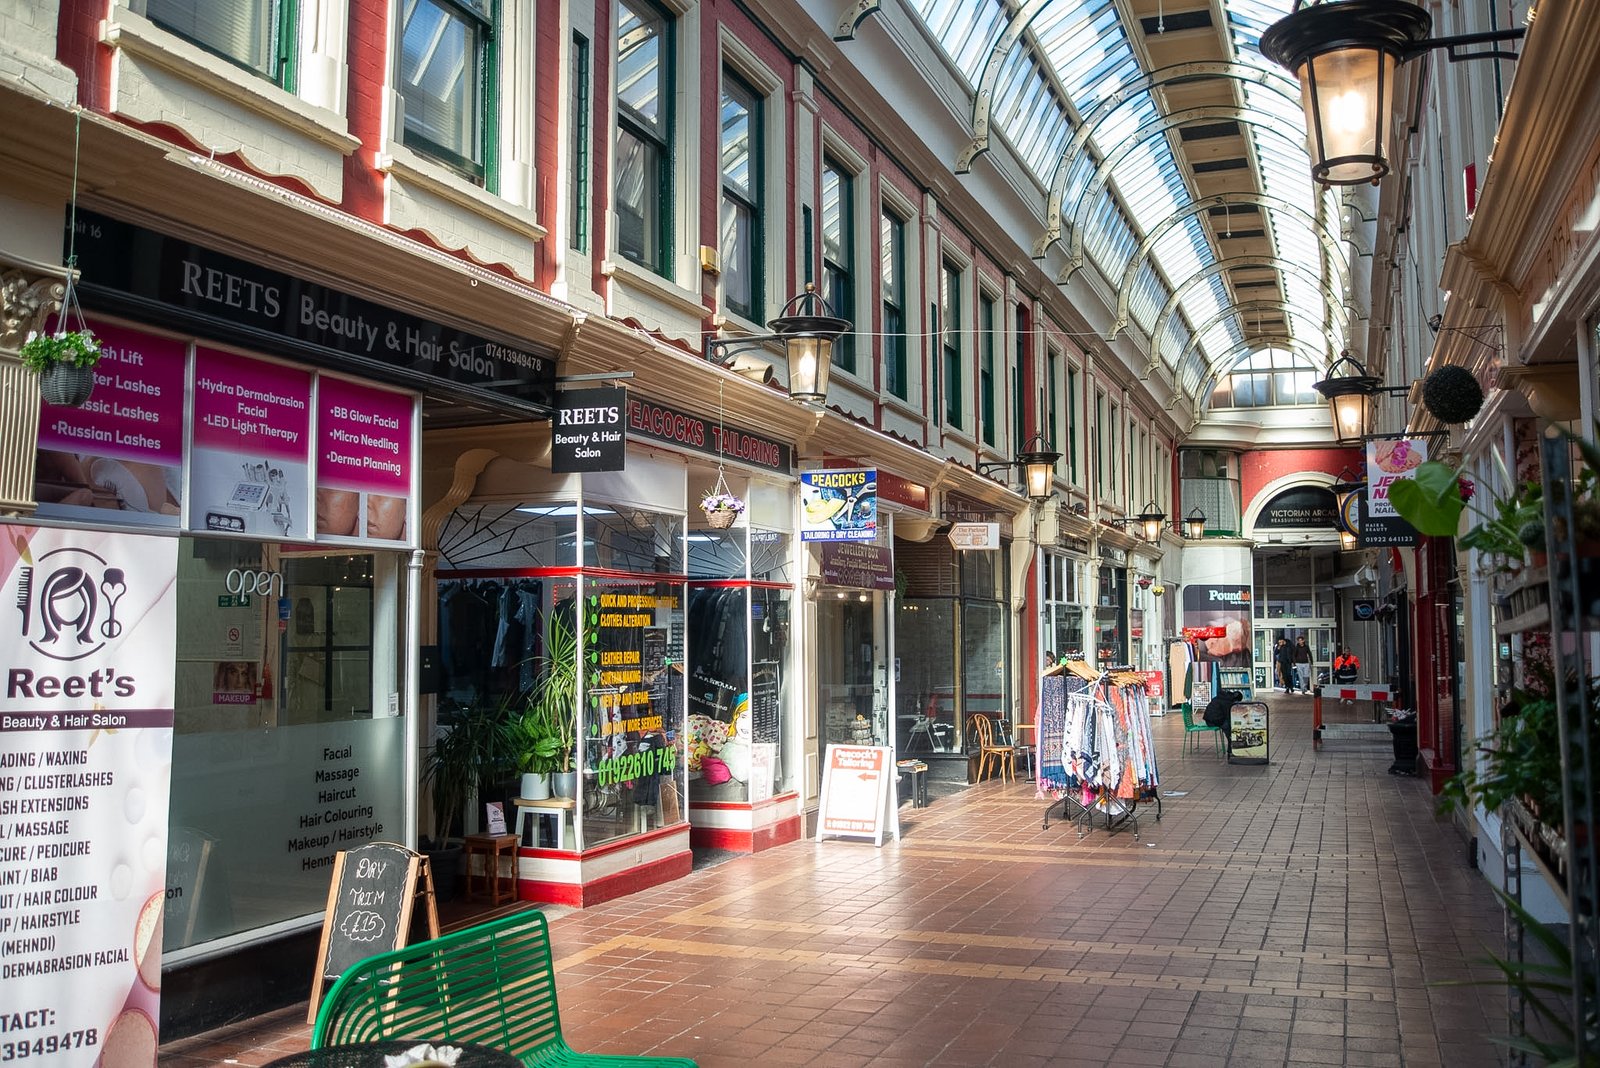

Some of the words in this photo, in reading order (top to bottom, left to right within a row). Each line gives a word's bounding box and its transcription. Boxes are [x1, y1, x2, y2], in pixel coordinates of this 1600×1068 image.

[90, 224, 102, 238] 16
[181, 260, 280, 318] REETS
[301, 294, 378, 352] Beauty
[385, 321, 400, 351] &
[406, 326, 443, 362] Hair
[449, 341, 494, 377] Salon
[485, 343, 542, 372] 07413949478
[100, 346, 117, 360] sh
[120, 348, 143, 366] Lift
[116, 375, 161, 396] Lashes
[202, 378, 234, 394] Hydra
[236, 385, 305, 409] Dermabrasion
[114, 402, 159, 422] Lashes
[237, 402, 268, 418] Facial
[334, 406, 348, 419] BB
[349, 409, 372, 424] Glow
[373, 414, 399, 429] Facial
[559, 406, 619, 426] REETS
[57, 420, 112, 442] Russian
[116, 430, 161, 450] Lashes
[207, 413, 229, 428] LED
[231, 418, 258, 435] Light
[259, 423, 299, 443] Therapy
[555, 433, 590, 445] Beauty
[591, 431, 600, 442] &
[601, 431, 621, 442] Hair
[333, 428, 359, 443] Micro
[361, 433, 399, 454] Needling
[712, 426, 780, 468] TAILORING
[574, 447, 601, 459] Salon
[330, 451, 361, 466] Derma
[363, 456, 401, 476] Planning
[811, 472, 866, 488] PEACOCKS
[1270, 509, 1310, 517] VICTORIAN
[1311, 509, 1338, 517] ARCAD
[804, 531, 830, 540] TAILORING
[836, 531, 847, 539] DRY
[226, 568, 284, 602] open
[218, 694, 250, 703] MAKEUP
[3, 715, 47, 730] Beauty
[50, 714, 61, 727] &
[64, 714, 89, 727] Hair
[92, 713, 127, 726] Salon
[0, 752, 36, 769] ADING
[46, 750, 88, 766] WAXING
[324, 745, 352, 760] Facial
[24, 772, 113, 790] CLUSTERLASHES
[315, 767, 359, 783] Massage
[21, 796, 89, 813] EXTENSIONS
[318, 786, 356, 803] Haircut
[300, 813, 322, 828] Hair
[324, 805, 373, 823] Colouring
[15, 820, 69, 837] MASSAGE
[288, 838, 330, 853] Makeup
[339, 823, 383, 839] Hairstyle
[37, 840, 91, 859] PEDICURE
[302, 854, 336, 871] Henna
[356, 858, 388, 879] DRY
[31, 867, 58, 882] BIAB
[24, 891, 51, 907] HAIR
[54, 885, 98, 904] COLOUR
[166, 886, 183, 899] on
[21, 909, 80, 930] HAIRSTYLE
[352, 914, 377, 933] £15
[2, 935, 56, 957] (MEHNDI)
[3, 955, 92, 979] DERMABRASION
[94, 948, 129, 965] FACIAL
[0, 1008, 55, 1033] TACT:
[2, 1028, 98, 1061] 3949478
